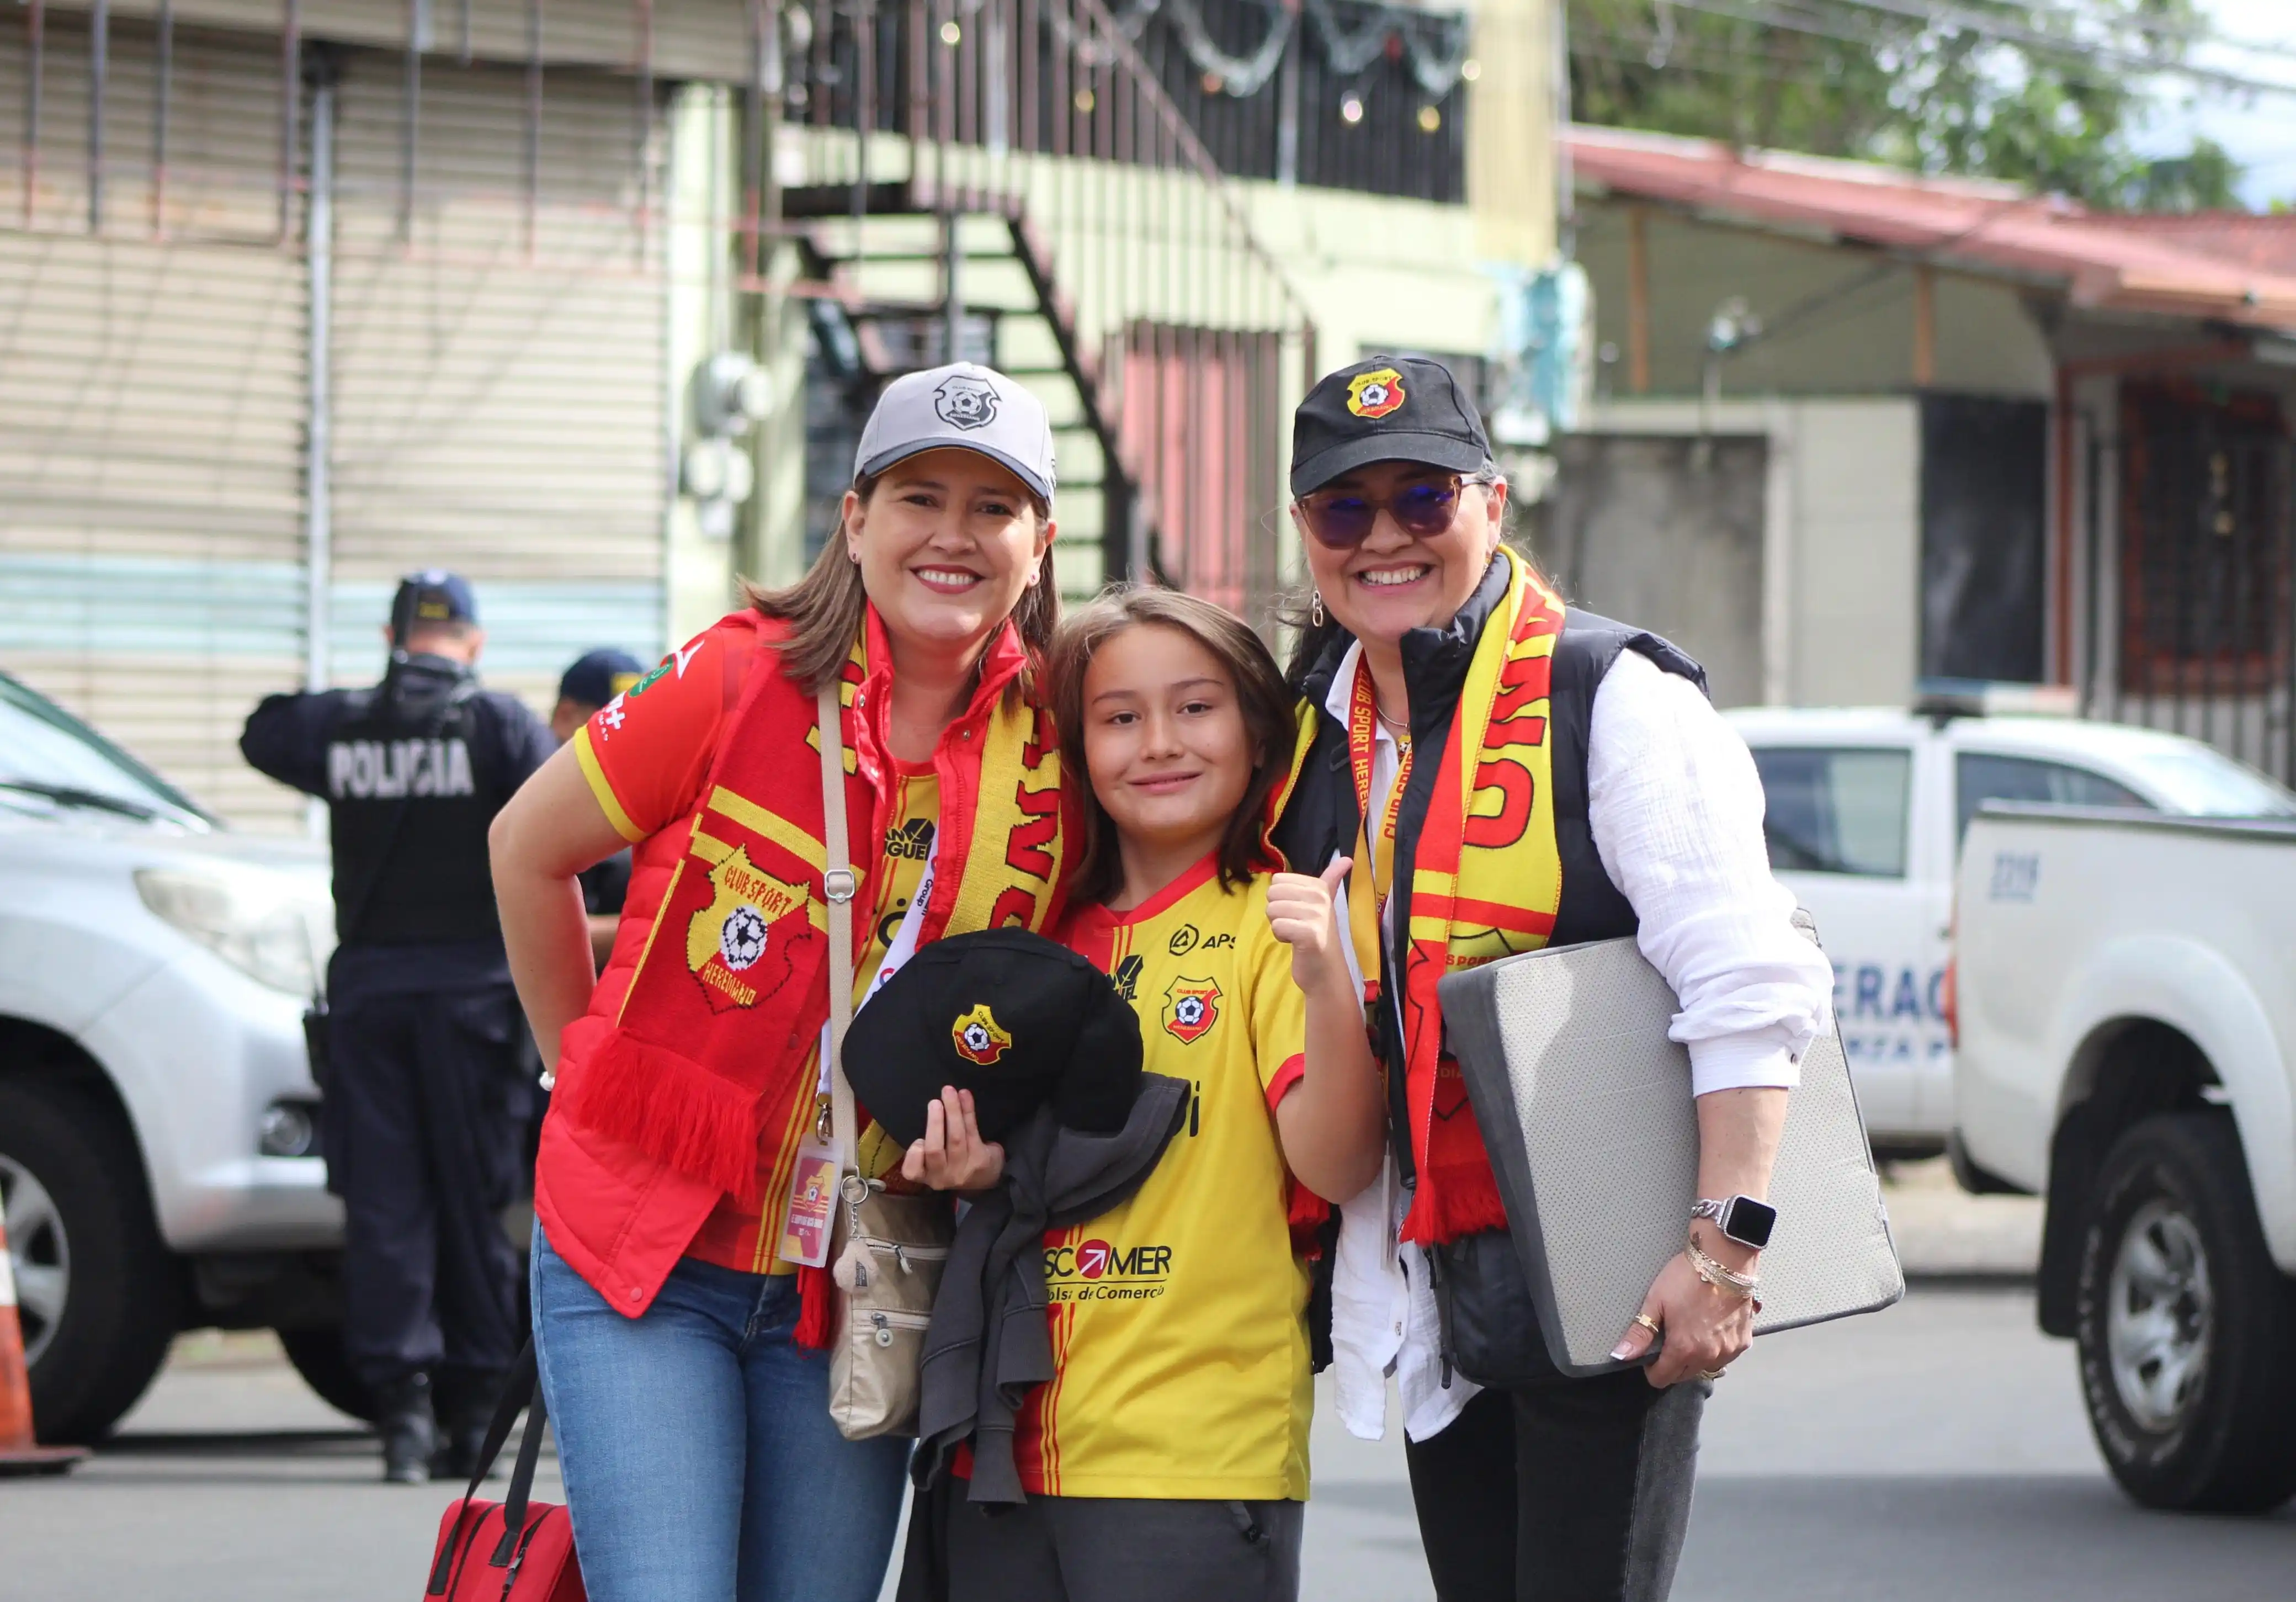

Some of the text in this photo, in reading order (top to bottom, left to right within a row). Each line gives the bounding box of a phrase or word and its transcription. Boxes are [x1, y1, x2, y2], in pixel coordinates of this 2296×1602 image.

[1356, 669, 1372, 705] CLUB
[1352, 706, 1372, 754] SPORT
[724, 865, 793, 917] CLUB SPORT
[916, 878, 934, 906] Group
